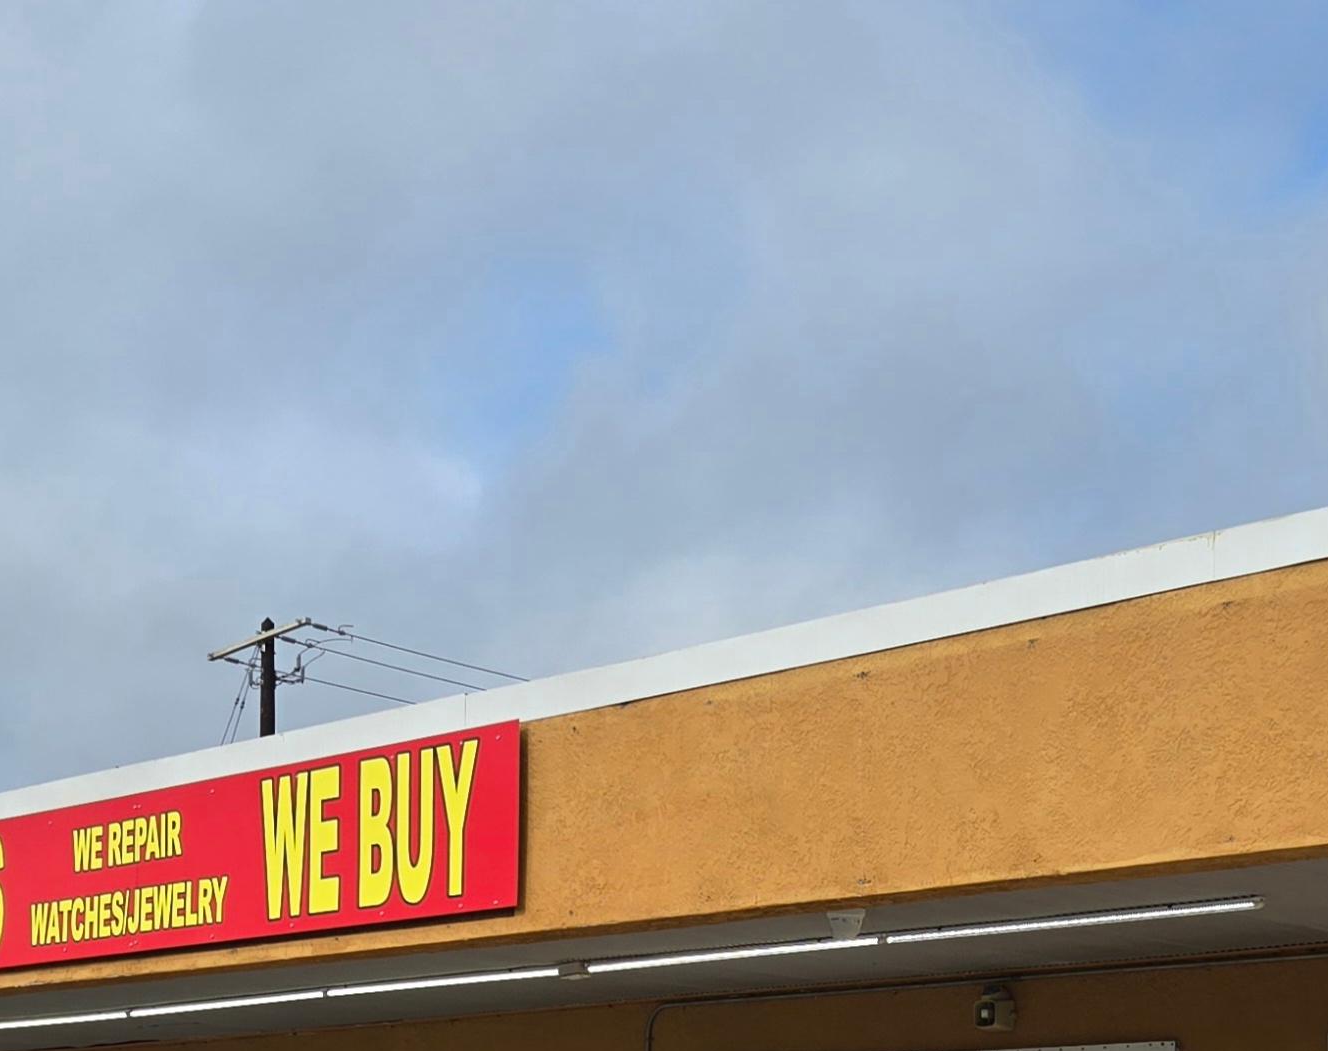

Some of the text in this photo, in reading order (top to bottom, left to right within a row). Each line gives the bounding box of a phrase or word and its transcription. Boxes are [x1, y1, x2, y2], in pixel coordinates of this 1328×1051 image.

[73, 811, 182, 872] WE REPAIR
[261, 739, 479, 921] WE BUY
